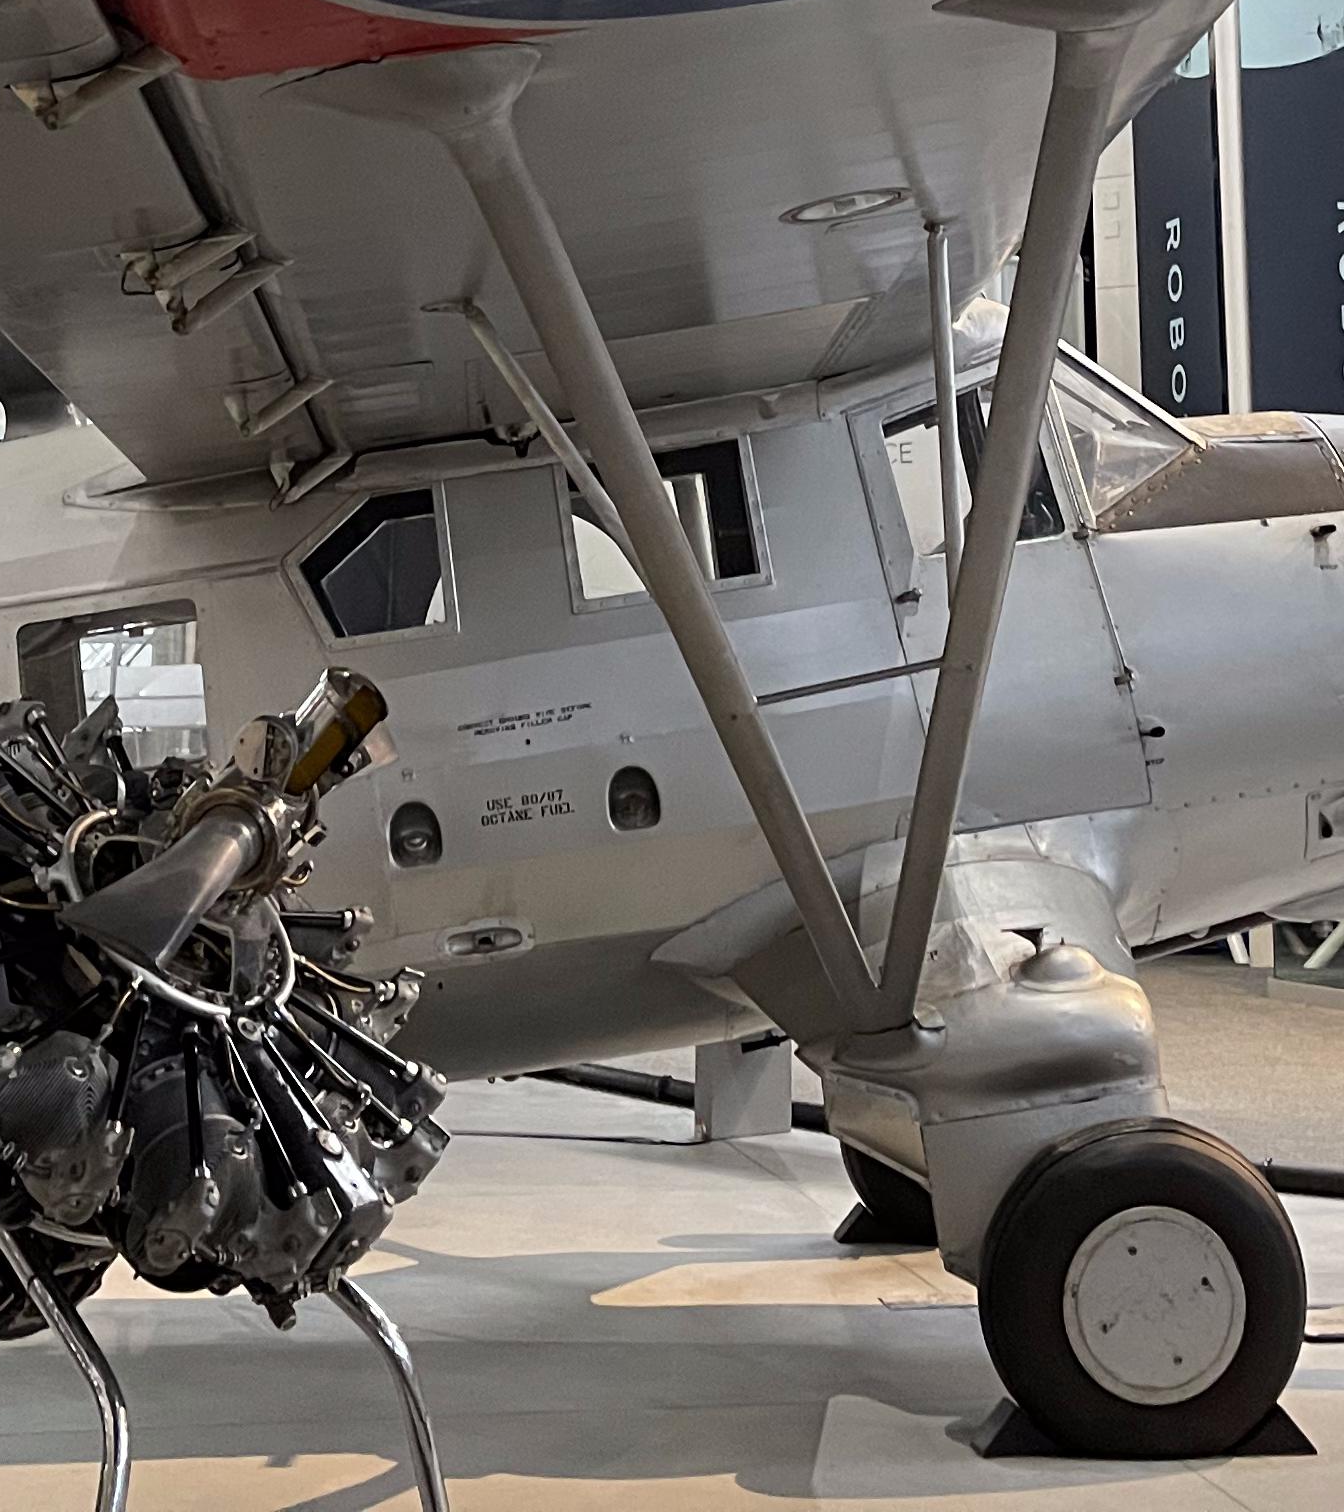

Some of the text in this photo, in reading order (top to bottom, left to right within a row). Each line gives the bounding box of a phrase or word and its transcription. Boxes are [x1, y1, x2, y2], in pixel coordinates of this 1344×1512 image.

[1165, 217, 1187, 403] ROBO
[480, 803, 575, 827] OCTANE FUEL
[486, 796, 514, 812] USE
